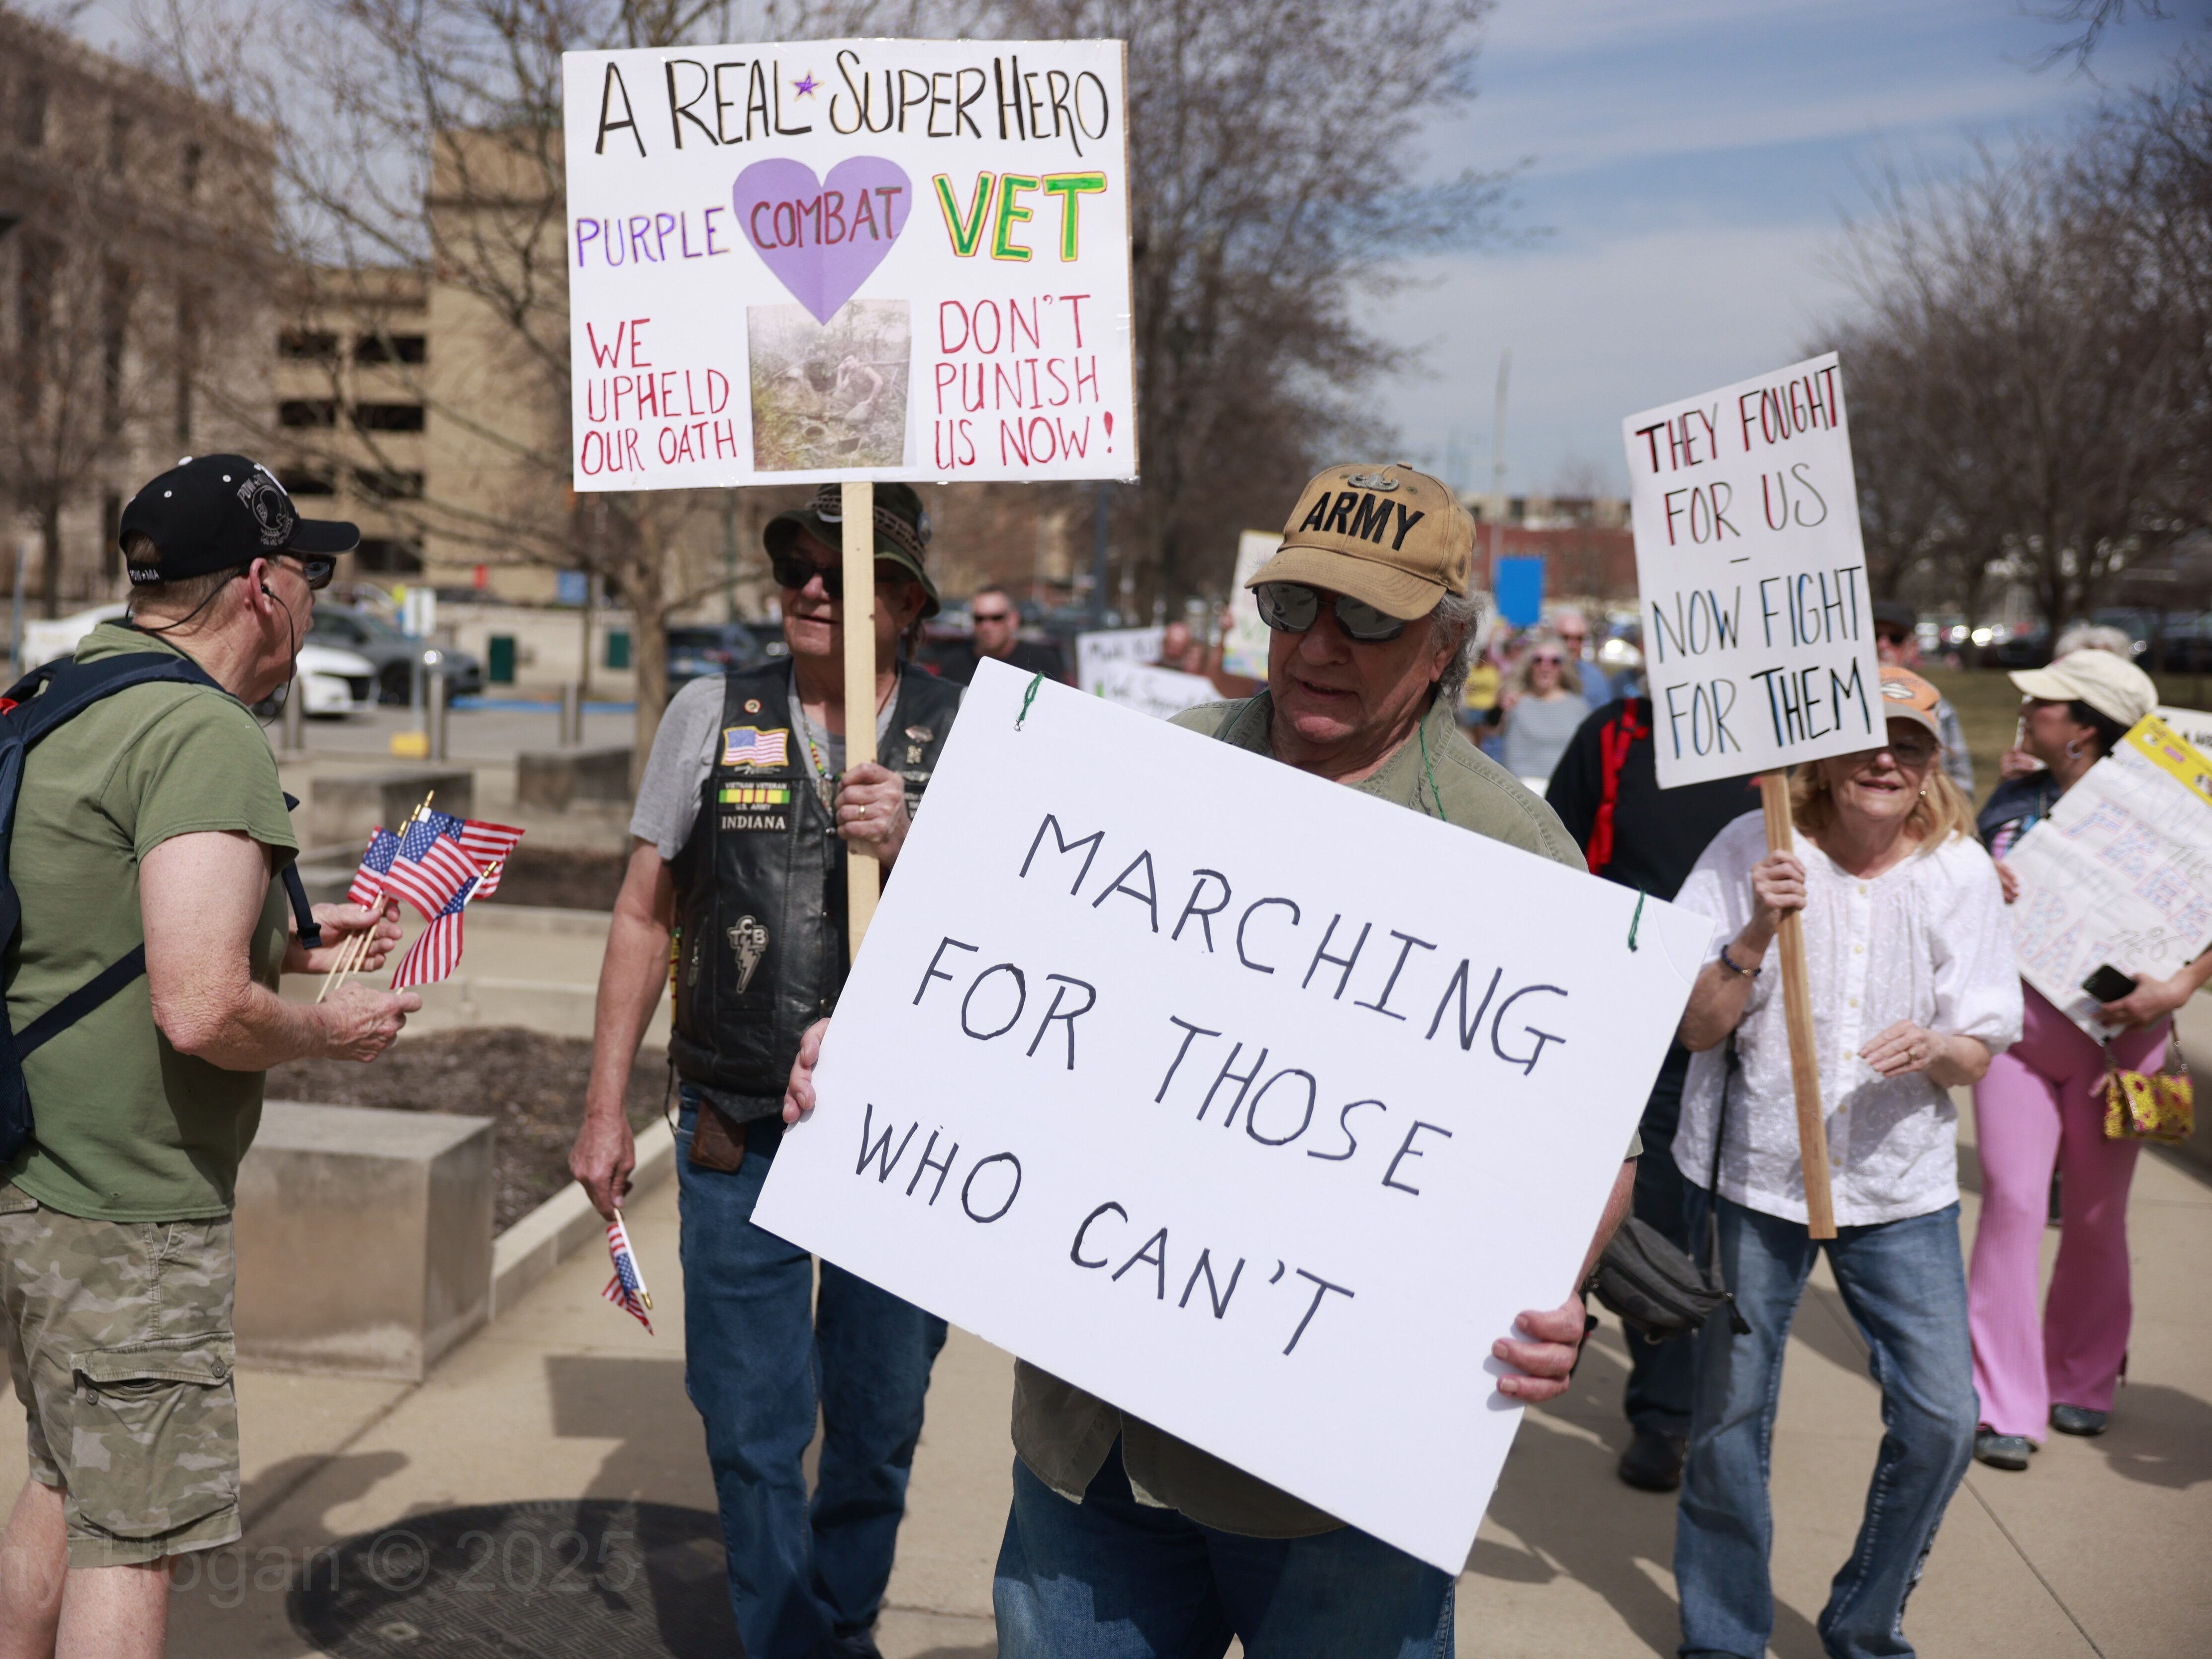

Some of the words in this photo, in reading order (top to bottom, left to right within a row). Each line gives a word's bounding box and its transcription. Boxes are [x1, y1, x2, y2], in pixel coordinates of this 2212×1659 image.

[595, 62, 647, 158] A
[665, 58, 813, 151] REAL
[576, 207, 729, 267] PURPLE
[750, 187, 902, 249] COMBAT
[932, 171, 1107, 262] VET
[586, 318, 652, 368] WE
[940, 294, 1090, 354] DON'T
[588, 369, 729, 422] UPHELD
[935, 355, 1098, 414] PUNISH
[1635, 404, 1717, 473] THEY
[1739, 366, 1837, 451] FOUGHT
[581, 428, 645, 475] OUR
[659, 419, 737, 465] OATH
[935, 419, 975, 470] US
[1299, 491, 1425, 551] ARMY
[1664, 482, 1740, 546] FOR
[1761, 464, 1827, 531] US
[1652, 586, 1740, 663] NOW
[1759, 566, 1862, 647] FIGHT
[1666, 679, 1741, 759] FOR
[1750, 657, 1871, 748] THEM
[725, 781, 755, 789] VIETNAM
[721, 815, 786, 830] INDIANA
[1020, 814, 1568, 1075] MARCHING
[912, 936, 1096, 1070] FOR
[1154, 1015, 1452, 1196] THOSE
[856, 1103, 1021, 1223] WHO
[1070, 1201, 1354, 1356] CAN'T
